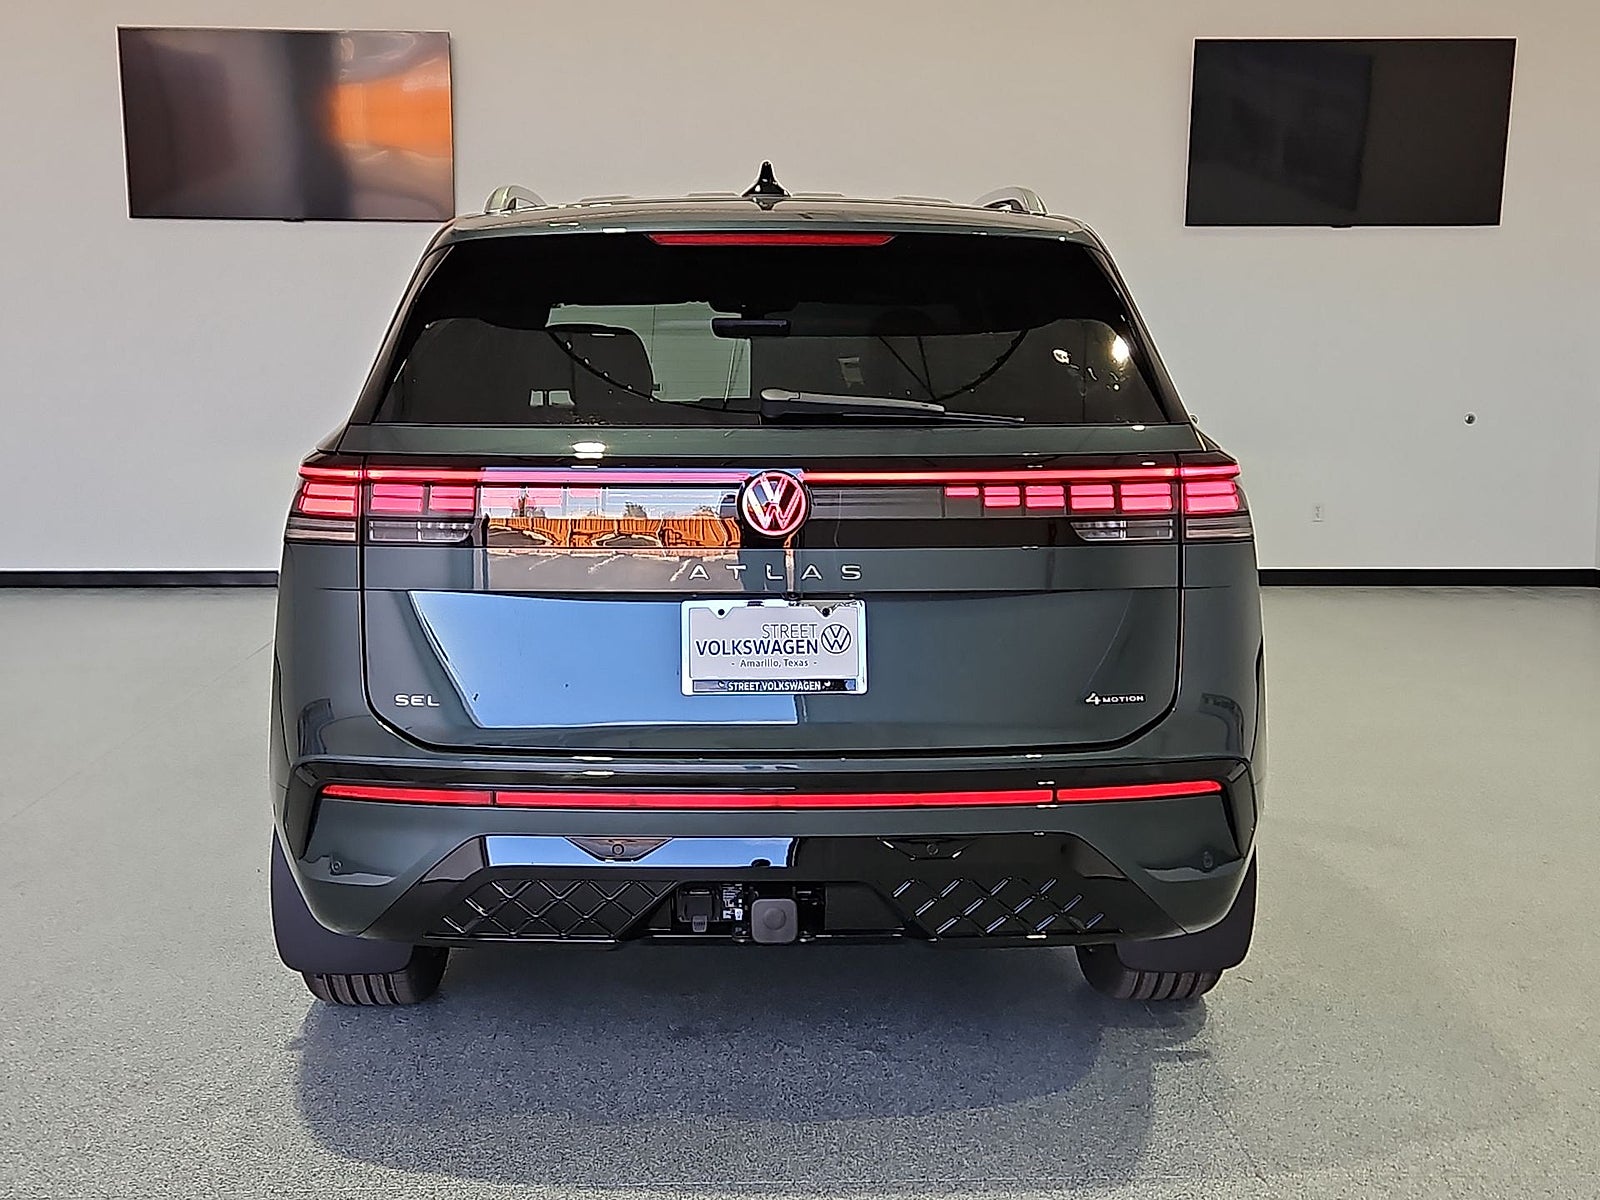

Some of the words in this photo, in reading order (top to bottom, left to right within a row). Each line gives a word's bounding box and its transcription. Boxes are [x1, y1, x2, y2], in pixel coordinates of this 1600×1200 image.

[689, 564, 861, 580] ATLAS
[761, 623, 818, 639] STREET
[695, 639, 818, 656] VOLKSWAGEN
[740, 659, 782, 668] Amarillo,
[783, 658, 809, 667] Texas
[728, 681, 761, 691] STREET
[761, 680, 822, 691] VOLKSWAGEN
[394, 694, 440, 707] SEL
